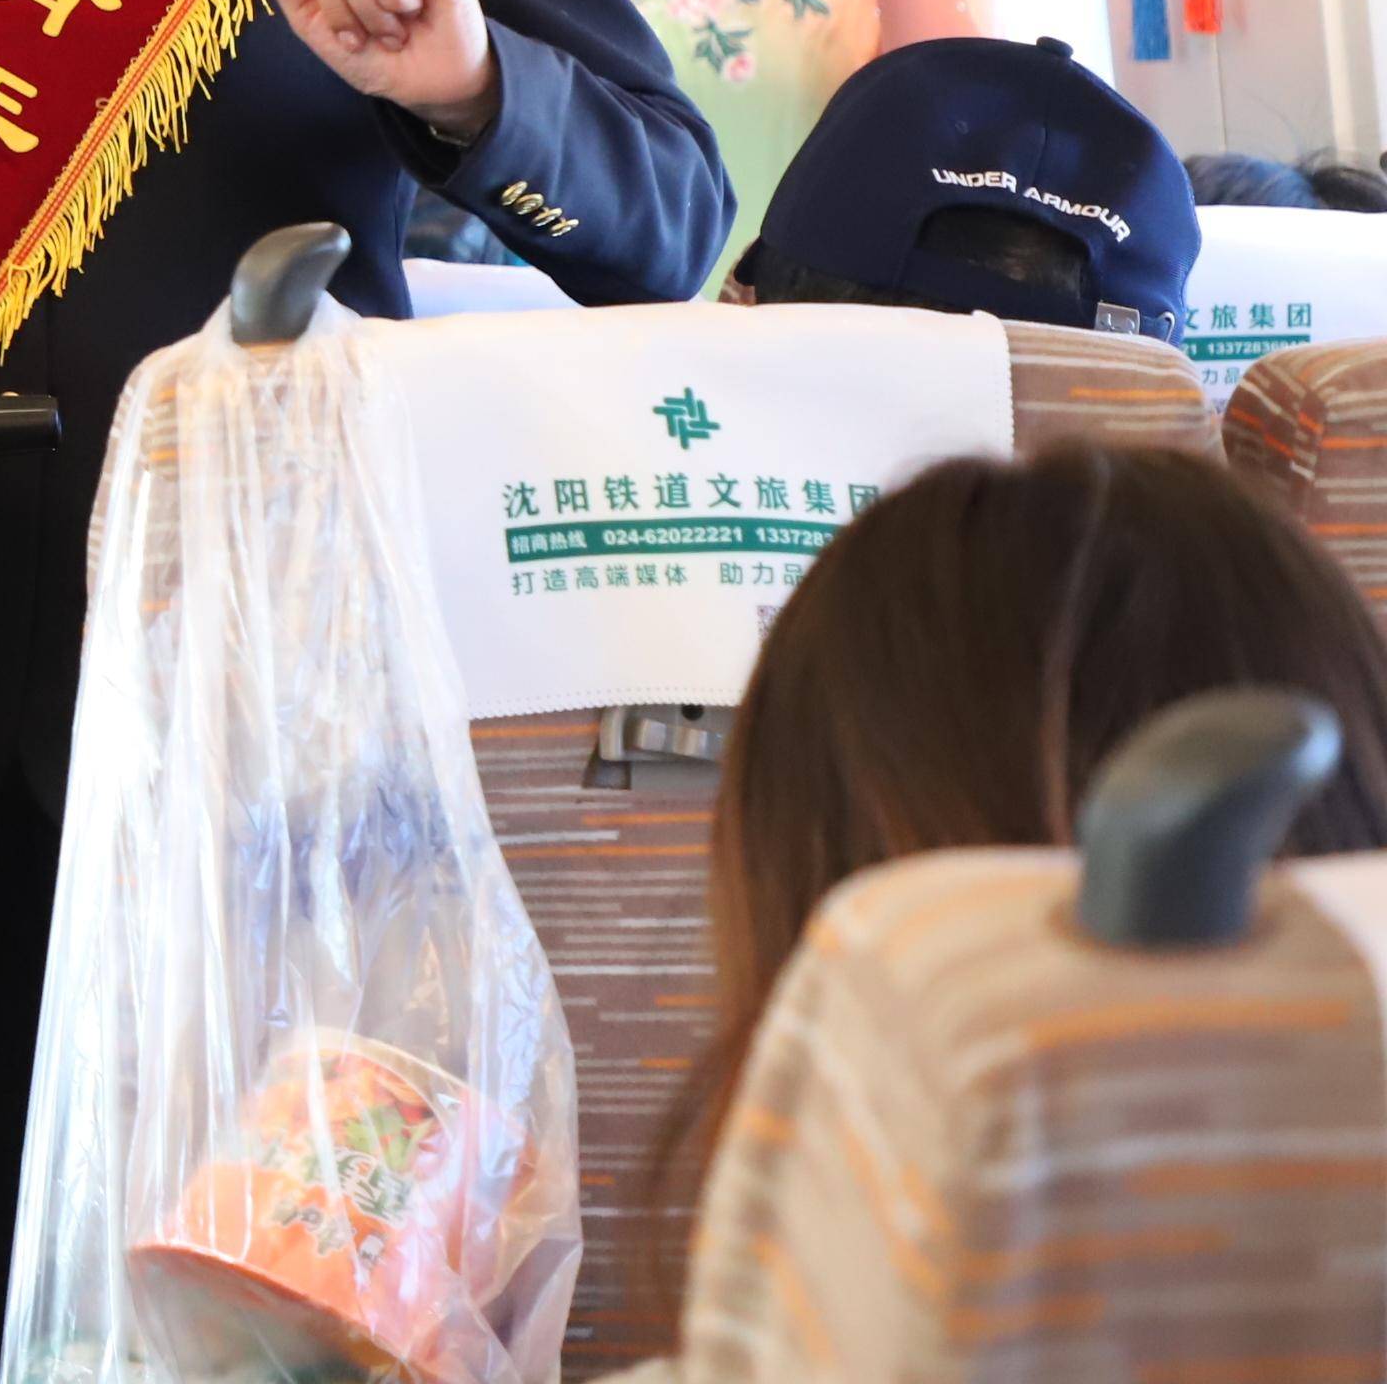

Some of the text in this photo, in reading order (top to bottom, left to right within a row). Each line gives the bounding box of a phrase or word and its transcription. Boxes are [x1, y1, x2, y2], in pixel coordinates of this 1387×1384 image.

[932, 167, 1131, 244] UNDER ARMOUR
[503, 473, 880, 519] 沈阳铁道文旅集团
[511, 532, 587, 556] 招商热线
[603, 526, 745, 548] 024-62022221
[511, 563, 689, 596] 打造高端媒体
